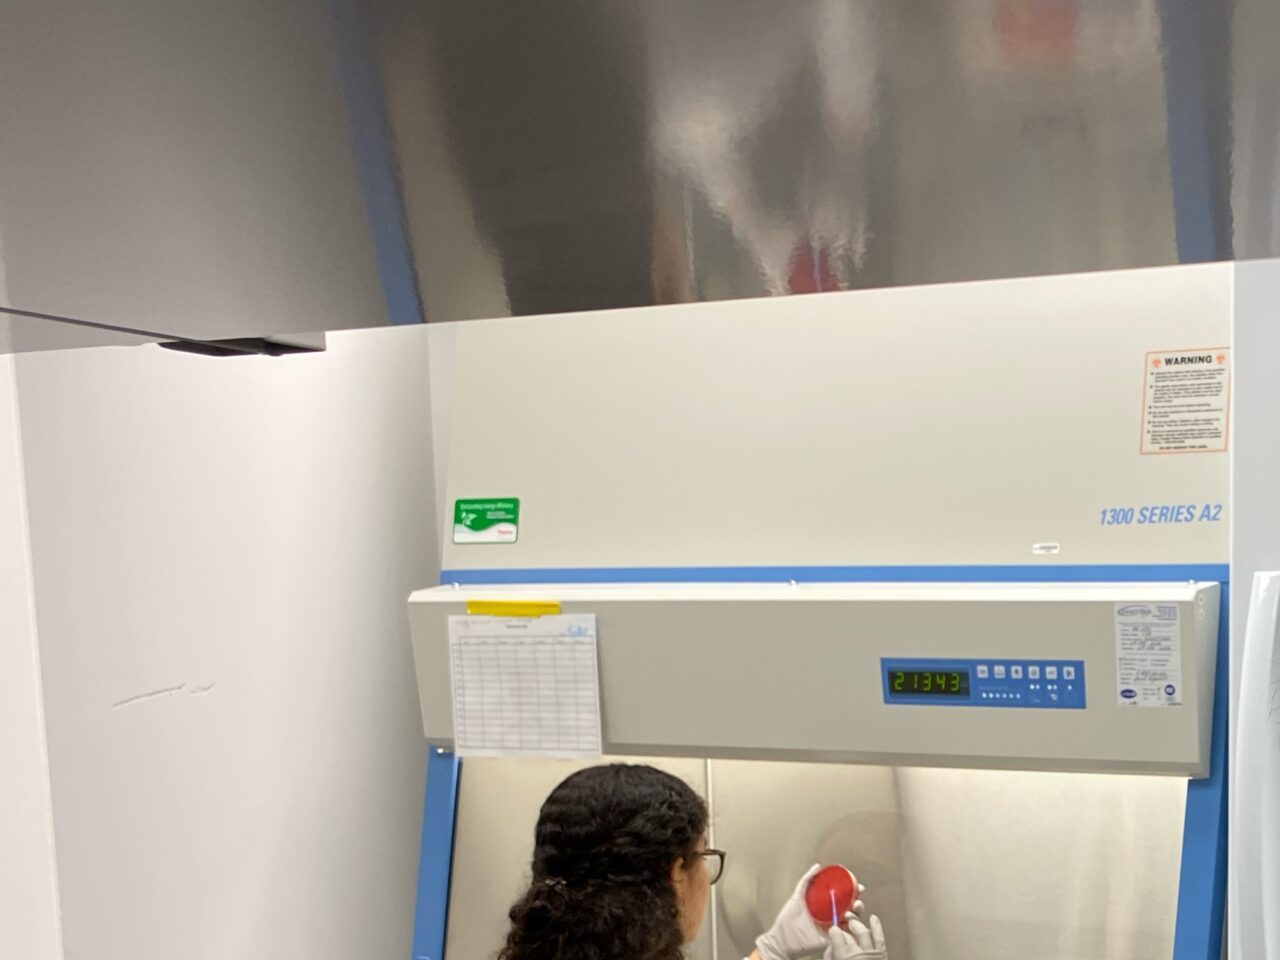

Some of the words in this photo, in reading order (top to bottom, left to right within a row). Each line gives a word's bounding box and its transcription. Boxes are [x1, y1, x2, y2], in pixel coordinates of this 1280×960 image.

[1164, 355, 1213, 366] WARNING
[1100, 508, 1134, 525] 1300
[1137, 505, 1196, 523] SERIES
[1200, 504, 1222, 522] A2
[893, 672, 960, 691] 21343
